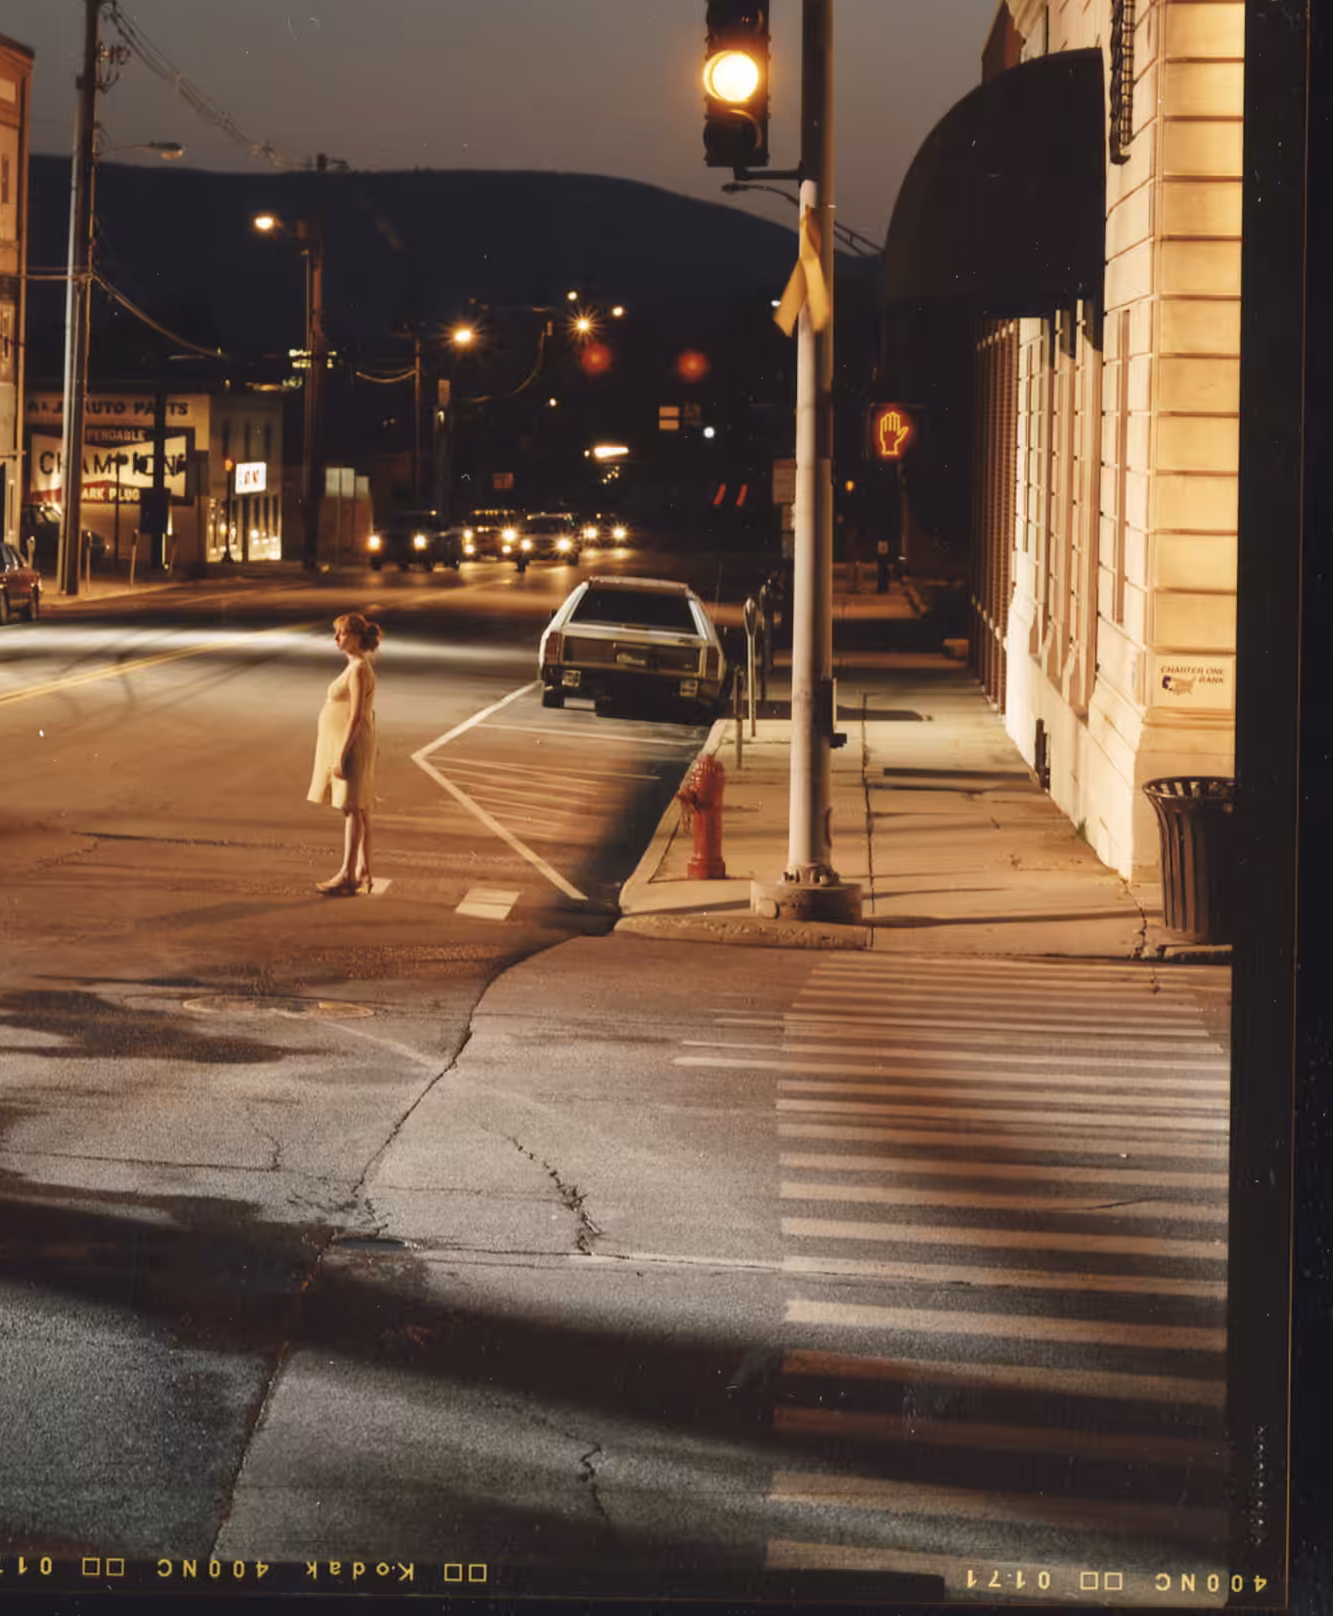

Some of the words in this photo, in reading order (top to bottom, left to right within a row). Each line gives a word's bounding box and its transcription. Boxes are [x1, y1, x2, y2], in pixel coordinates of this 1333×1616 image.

[134, 402, 188, 416] PATS
[158, 1559, 269, 1577] 400NC
[306, 1562, 414, 1580] Kodak
[966, 1569, 1050, 1589] 0171
[1155, 1573, 1267, 1593] 400NC
